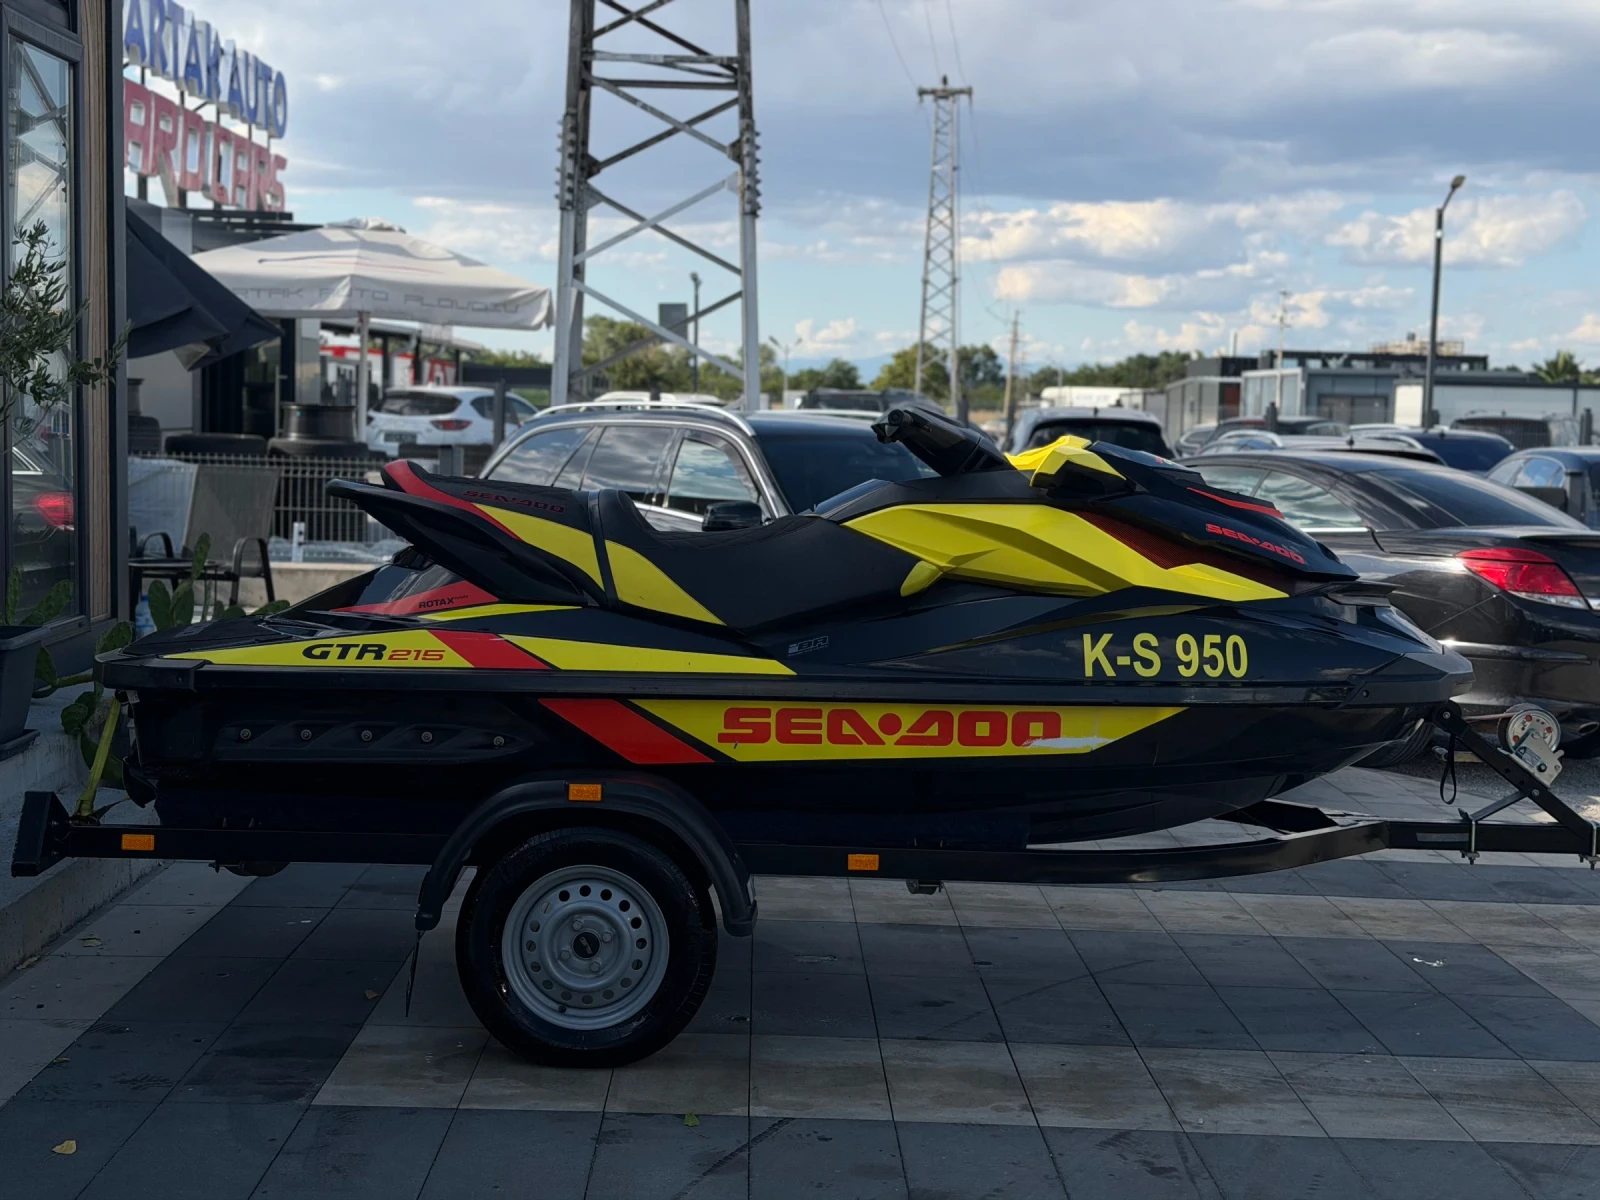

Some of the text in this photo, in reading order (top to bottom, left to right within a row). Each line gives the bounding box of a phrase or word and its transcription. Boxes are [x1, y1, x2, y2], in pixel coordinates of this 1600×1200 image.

[228, 47, 287, 138] AUTO
[418, 597, 455, 609] ROTAX
[302, 643, 446, 661] GTR 215
[1083, 632, 1248, 679] K-S 950
